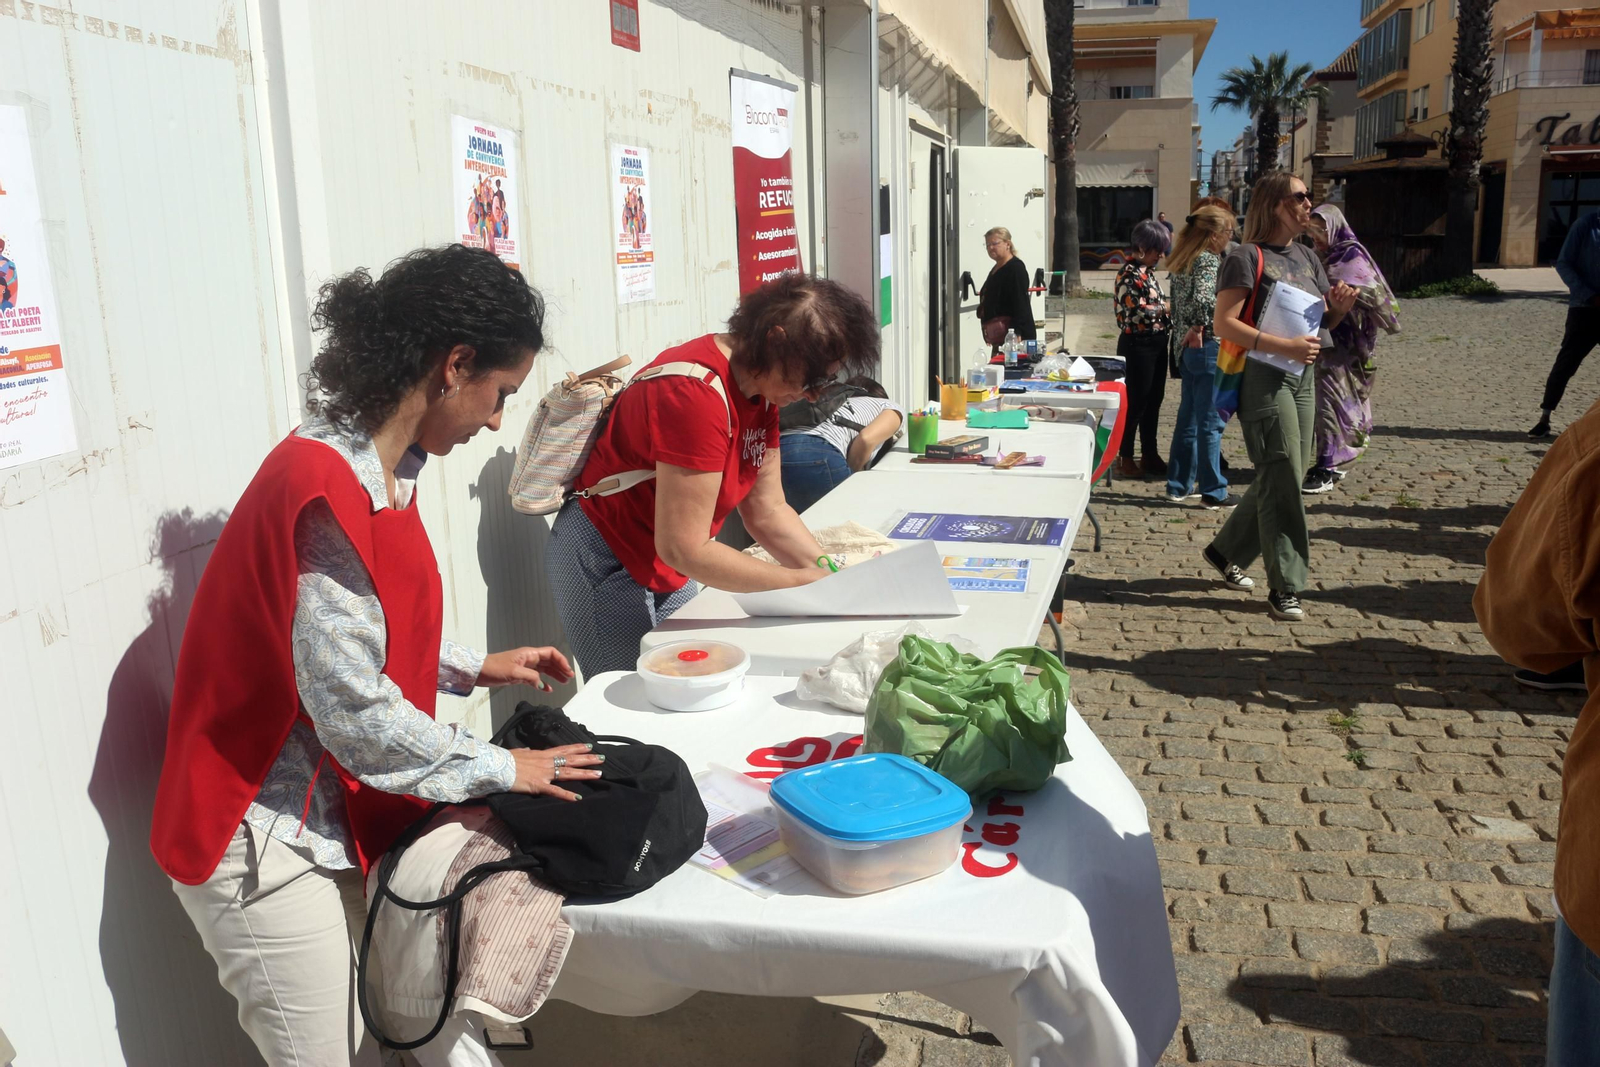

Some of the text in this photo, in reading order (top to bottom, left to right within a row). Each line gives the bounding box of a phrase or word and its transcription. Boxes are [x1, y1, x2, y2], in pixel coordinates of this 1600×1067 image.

[468, 134, 504, 158] JORNADA
[466, 148, 506, 167] DE CONVIVENCIA
[464, 158, 508, 179] INTERCULTURAL
[760, 177, 768, 188] Yo
[755, 227, 783, 241] Acogida
[5, 308, 17, 318] del
[18, 306, 41, 317] POETA
[12, 316, 41, 328] ALBERTI
[17, 376, 49, 387] culturales.
[0, 401, 37, 425] ulturas!
[742, 427, 766, 450] Have
[750, 441, 767, 467] gre
[962, 796, 1024, 878] Cár
